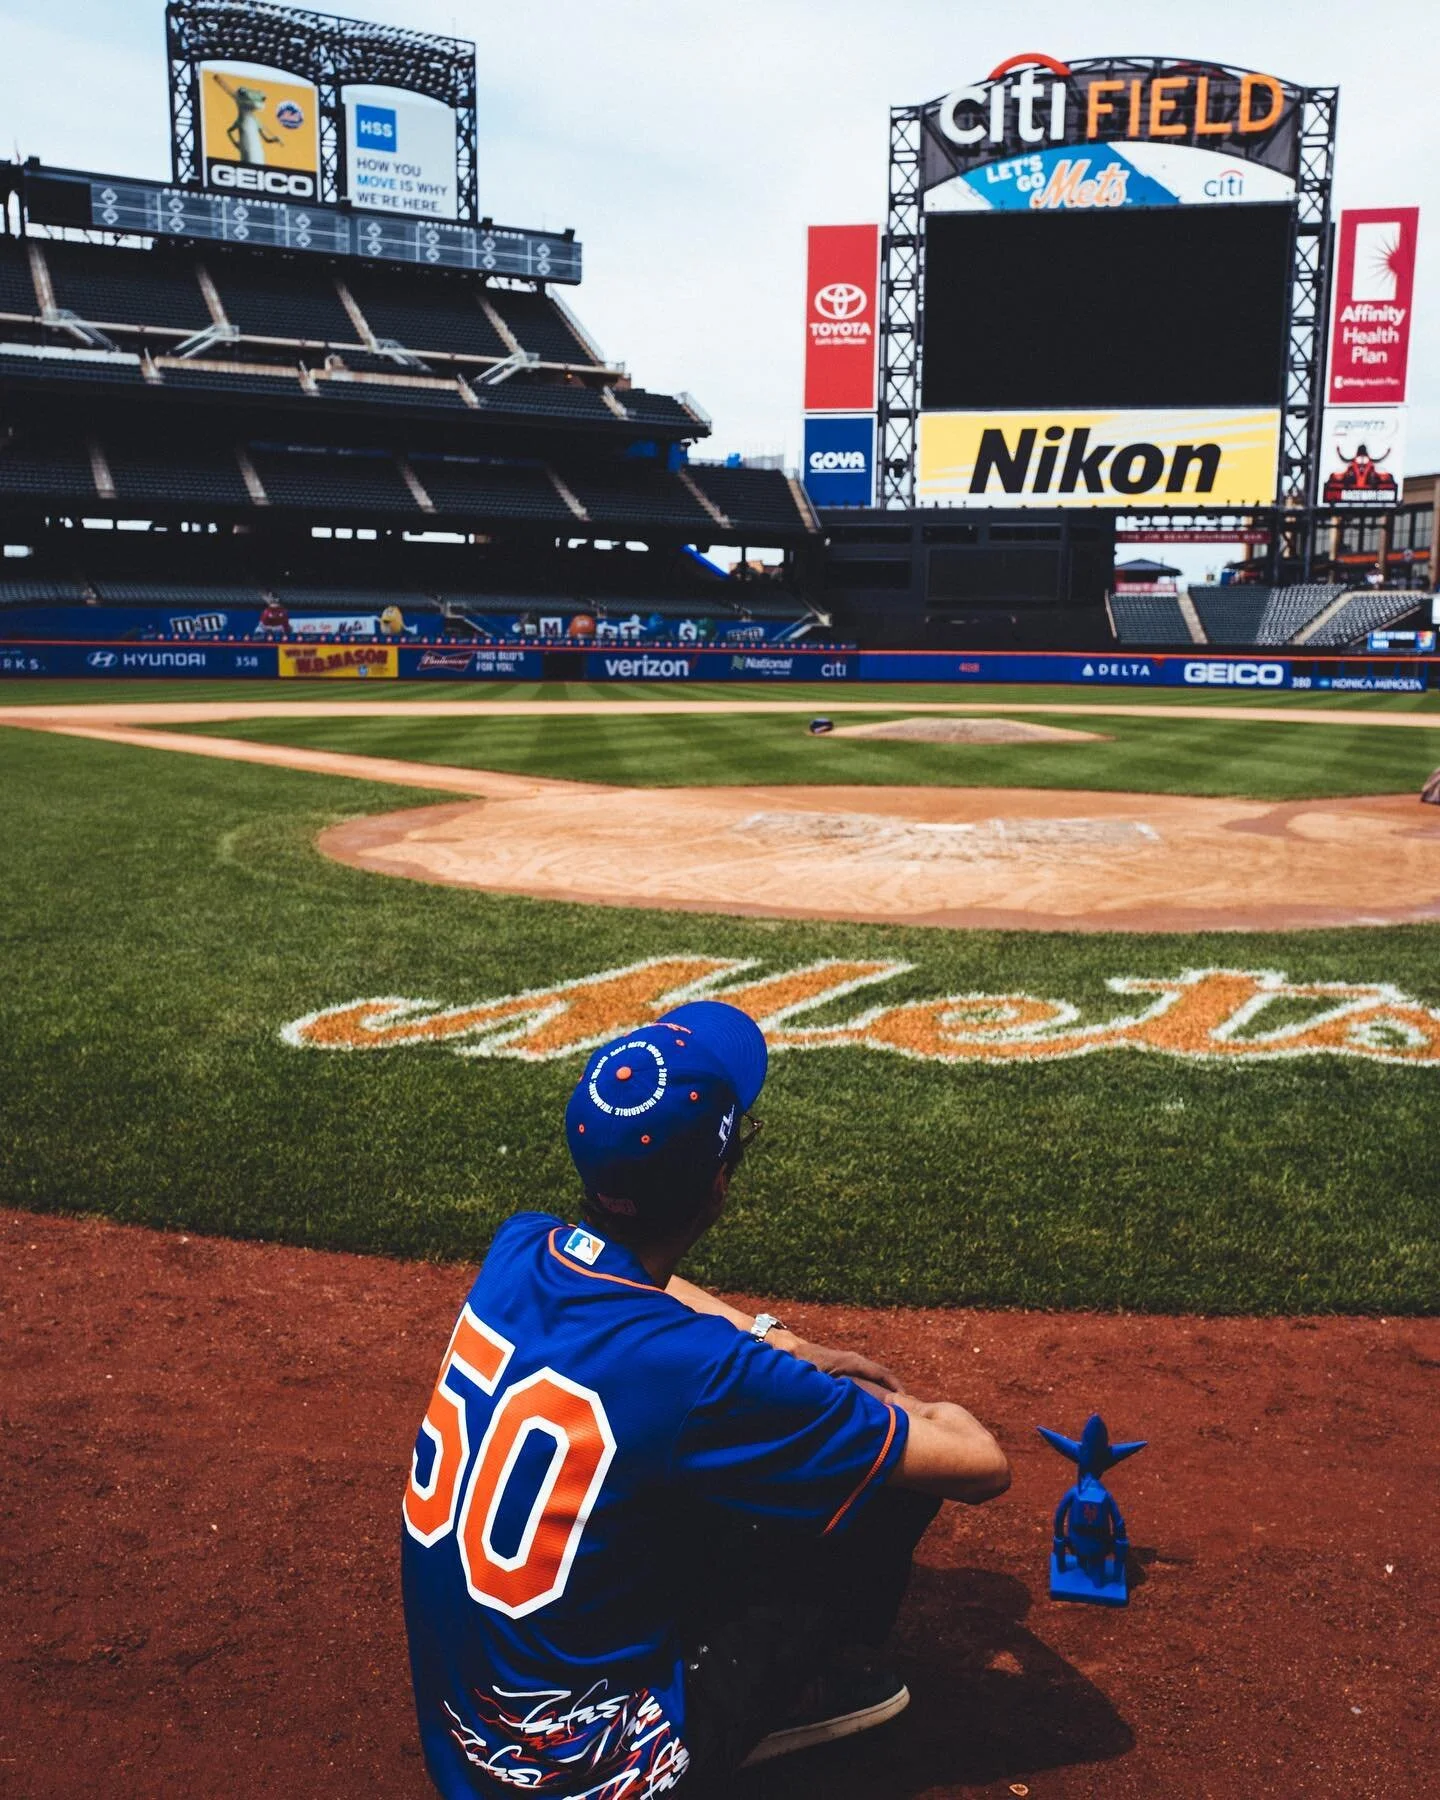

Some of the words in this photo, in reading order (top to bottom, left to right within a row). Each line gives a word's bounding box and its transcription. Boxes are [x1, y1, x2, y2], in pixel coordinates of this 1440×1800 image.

[939, 68, 1066, 144] citi
[1087, 73, 1285, 138] FIELD
[360, 120, 393, 138] HSS
[357, 158, 389, 172] HOW
[393, 163, 421, 177] YOU
[986, 155, 1043, 183] LET'S
[211, 164, 313, 197] GEICO
[357, 174, 396, 190] MOVE
[400, 180, 413, 192] IS
[416, 182, 447, 196] WHY
[1017, 171, 1046, 192] GO
[1029, 159, 1130, 209] Mets
[1204, 175, 1243, 197] citi
[357, 192, 399, 207] WE'RE
[1340, 305, 1405, 326] Affinity
[809, 322, 872, 337] TOYOTA
[1343, 326, 1399, 345] Health
[1351, 346, 1388, 364] Plan
[809, 451, 865, 470] GOYA
[968, 426, 1222, 494] Nikon
[123, 652, 206, 667] HYUNDAI
[235, 655, 258, 667] 358
[604, 655, 688, 677] verizon
[745, 657, 793, 669] National
[821, 661, 847, 677] citi
[1098, 663, 1150, 677] DELTA
[1184, 662, 1284, 685] GEICO
[1331, 678, 1372, 688] KONICA
[1373, 678, 1422, 690] MINOLTA
[281, 955, 1440, 1067] Mets
[614, 1097, 657, 1117] INCREDIBLE
[402, 1302, 617, 1620] 50
